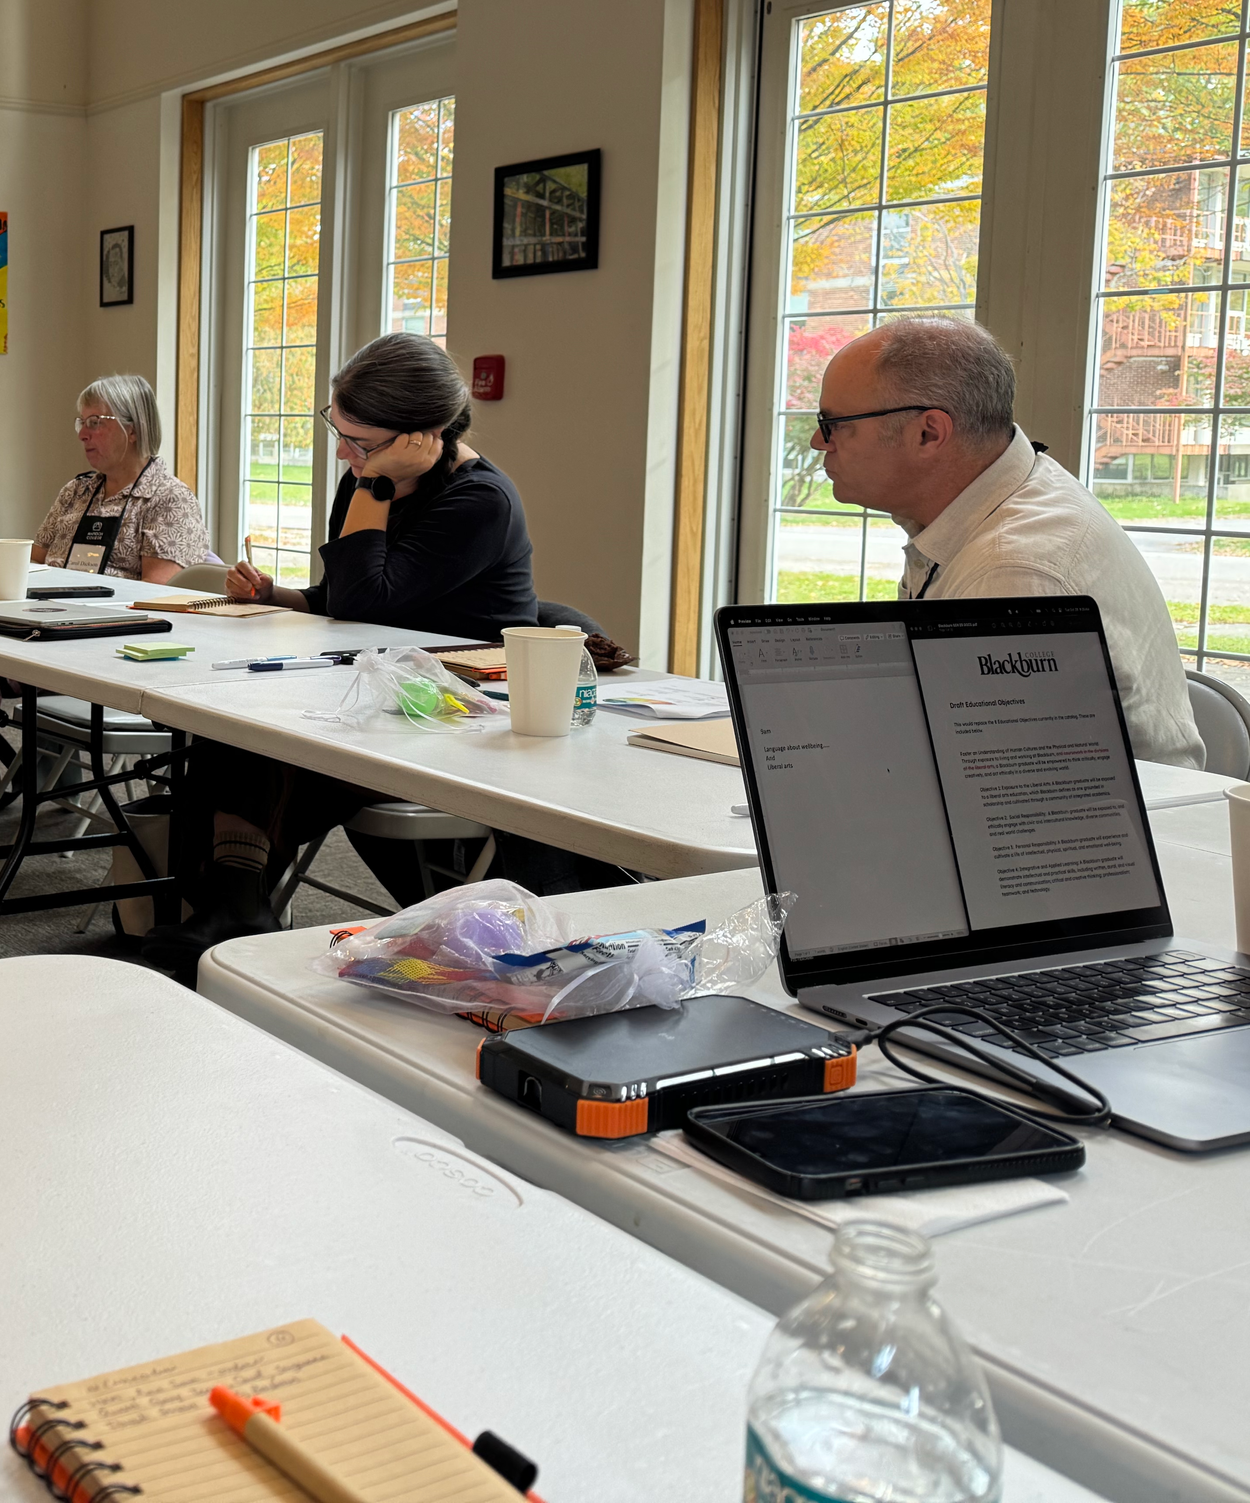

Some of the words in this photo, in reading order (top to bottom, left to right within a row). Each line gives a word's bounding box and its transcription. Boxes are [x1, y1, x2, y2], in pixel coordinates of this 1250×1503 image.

[977, 652, 1059, 677] Blackburn
[965, 699, 996, 708] Educational
[998, 698, 1025, 708] Objectives
